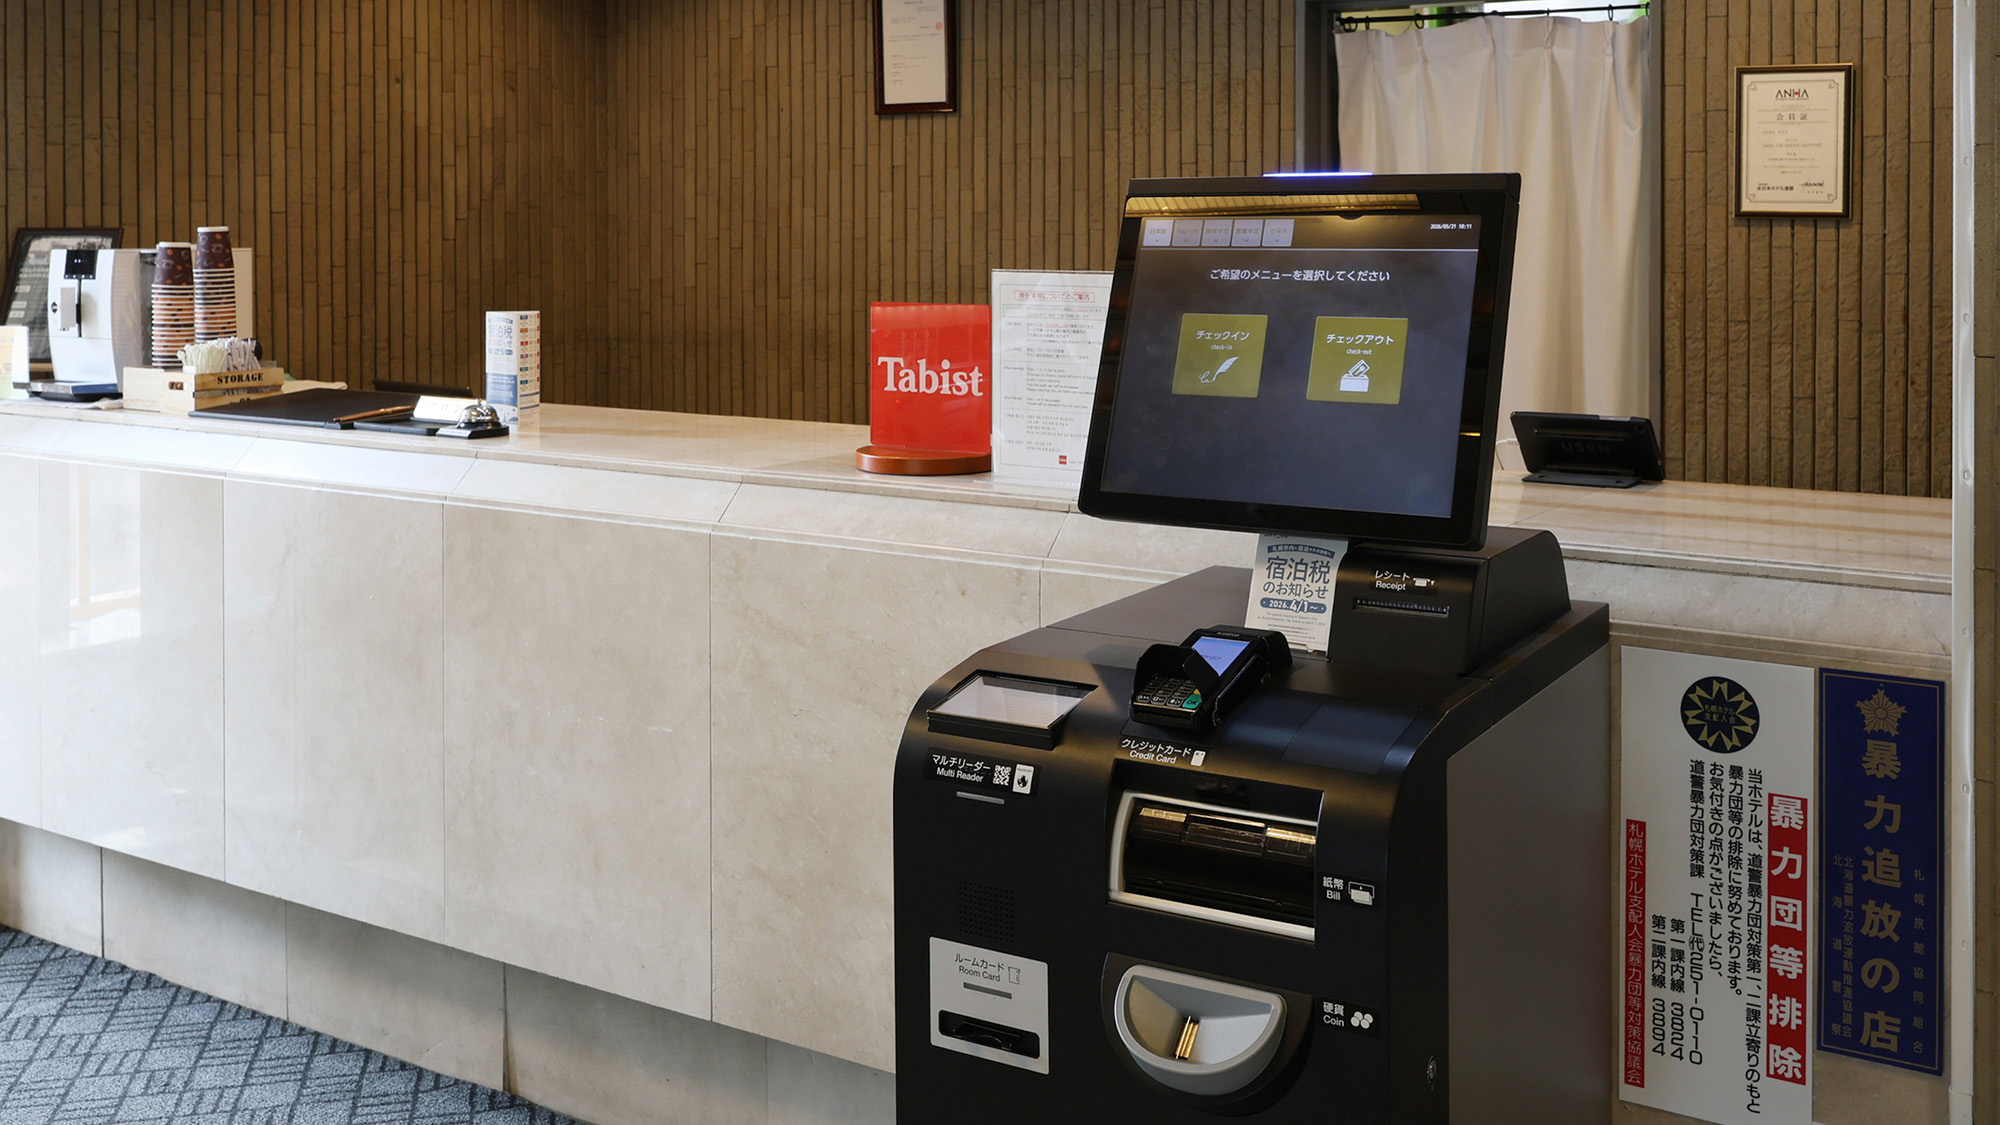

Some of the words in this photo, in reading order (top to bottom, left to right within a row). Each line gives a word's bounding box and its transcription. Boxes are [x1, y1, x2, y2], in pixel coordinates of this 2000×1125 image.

[1775, 89, 1809, 98] ANHA
[1209, 268, 1391, 283] ご希望のメニューを選択してください
[1196, 330, 1251, 342] チェックイン
[1326, 333, 1395, 346] チェックアウト
[1210, 343, 1233, 351] check-in
[1346, 348, 1373, 356] check-out
[217, 372, 264, 385] STORAGE
[878, 356, 984, 397] Tabist
[1561, 441, 1612, 454] USEN
[1265, 556, 1331, 585] 宿泊税
[1375, 570, 1411, 582] レシート
[1263, 581, 1329, 599] のお知らせ
[1375, 581, 1407, 591] Receipt
[1121, 738, 1192, 757] クレジットカード
[932, 754, 991, 772] マルチリーダー
[1129, 750, 1155, 761] Credit
[1156, 753, 1177, 764] Card
[936, 767, 956, 777] Multi
[956, 770, 984, 783] Reader
[1689, 759, 1705, 879] 道警暴力団対策課
[1708, 761, 1724, 978] お気付きの点がございましたら、
[1322, 876, 1344, 890] 紙幣
[1727, 764, 1743, 996] 暴力団等の排除に努めております。
[1326, 889, 1341, 901] Bill
[1860, 738, 1903, 1053] 暴力追放の店
[1745, 768, 1763, 1114] 当ホテルは、道警暴力団対策第一、二課立寄りのもと
[1769, 795, 1804, 1080] 暴力団等排除
[1627, 822, 1644, 1085] 札幌ホテル支配人会暴力団等対策協議会
[1651, 914, 1667, 989] 第二課内線
[1670, 918, 1686, 994] 第一課内線
[954, 952, 1005, 973] ルームカード
[1912, 868, 1926, 1055] 札幌旅館協同組合
[958, 965, 981, 978] Room
[981, 971, 1001, 983] Card
[1323, 1001, 1345, 1017] 硬貨
[1323, 1015, 1345, 1027] Coin
[1651, 997, 1666, 1057] 3894
[1670, 1001, 1685, 1061] 3824
